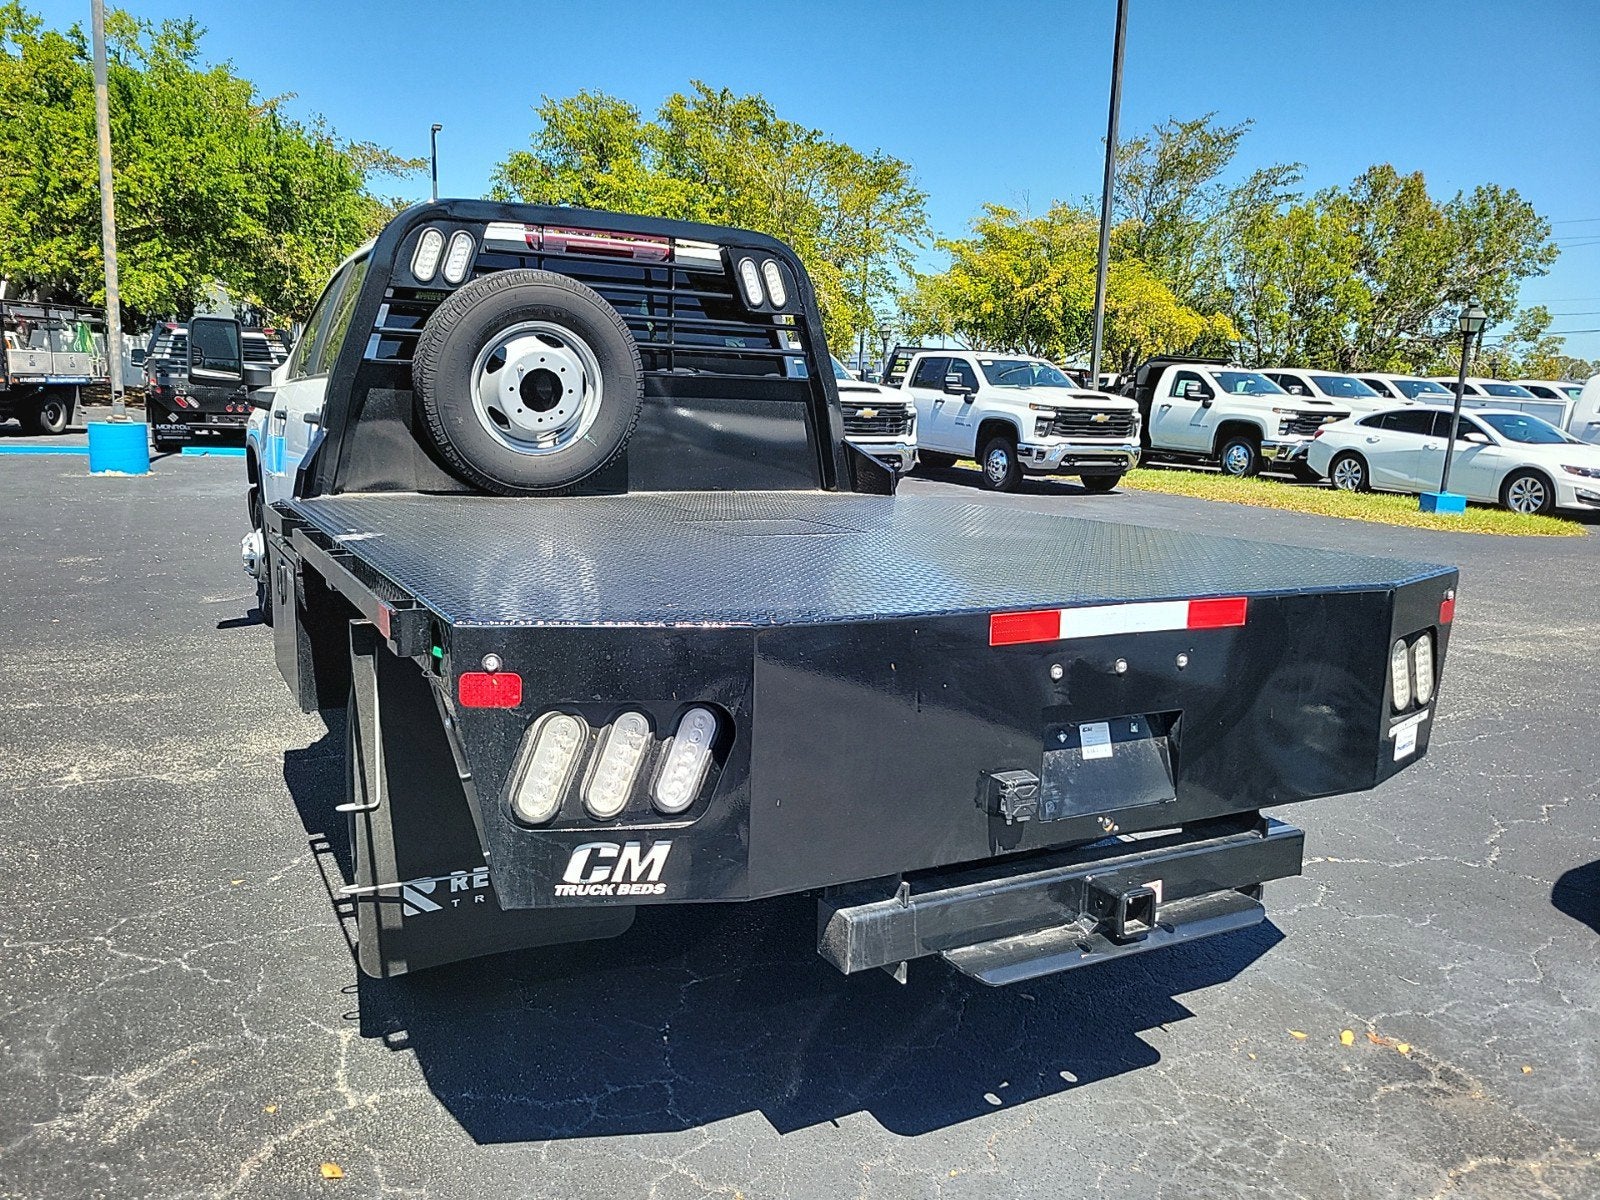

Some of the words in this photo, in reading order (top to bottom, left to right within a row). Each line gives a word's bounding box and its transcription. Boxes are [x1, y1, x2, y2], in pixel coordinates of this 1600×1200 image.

[562, 840, 673, 884] CM
[554, 883, 616, 897] TRUCK
[616, 882, 667, 896] BEDS
